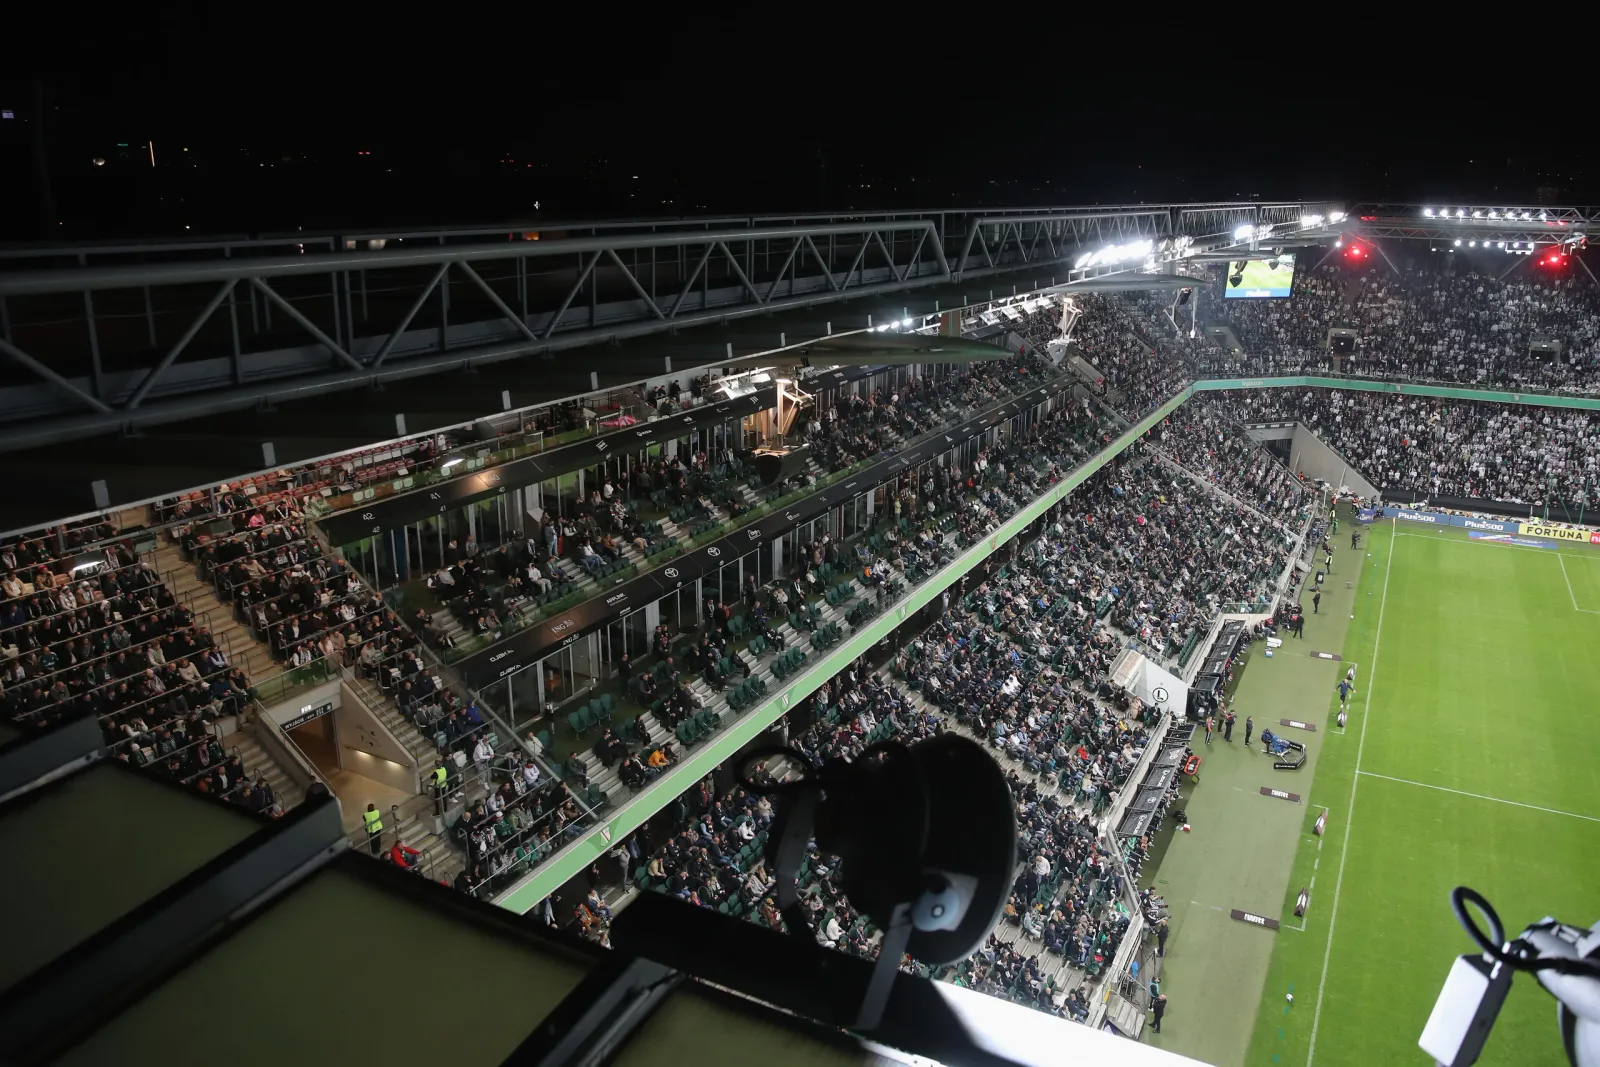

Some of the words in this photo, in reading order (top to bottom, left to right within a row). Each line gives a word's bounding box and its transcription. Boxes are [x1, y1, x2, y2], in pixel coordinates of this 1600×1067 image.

[430, 492, 441, 500] 41
[362, 512, 375, 521] 42
[1398, 512, 1435, 522] Plus500
[1464, 520, 1504, 531] Plus500
[1526, 526, 1583, 541] FORTUNA
